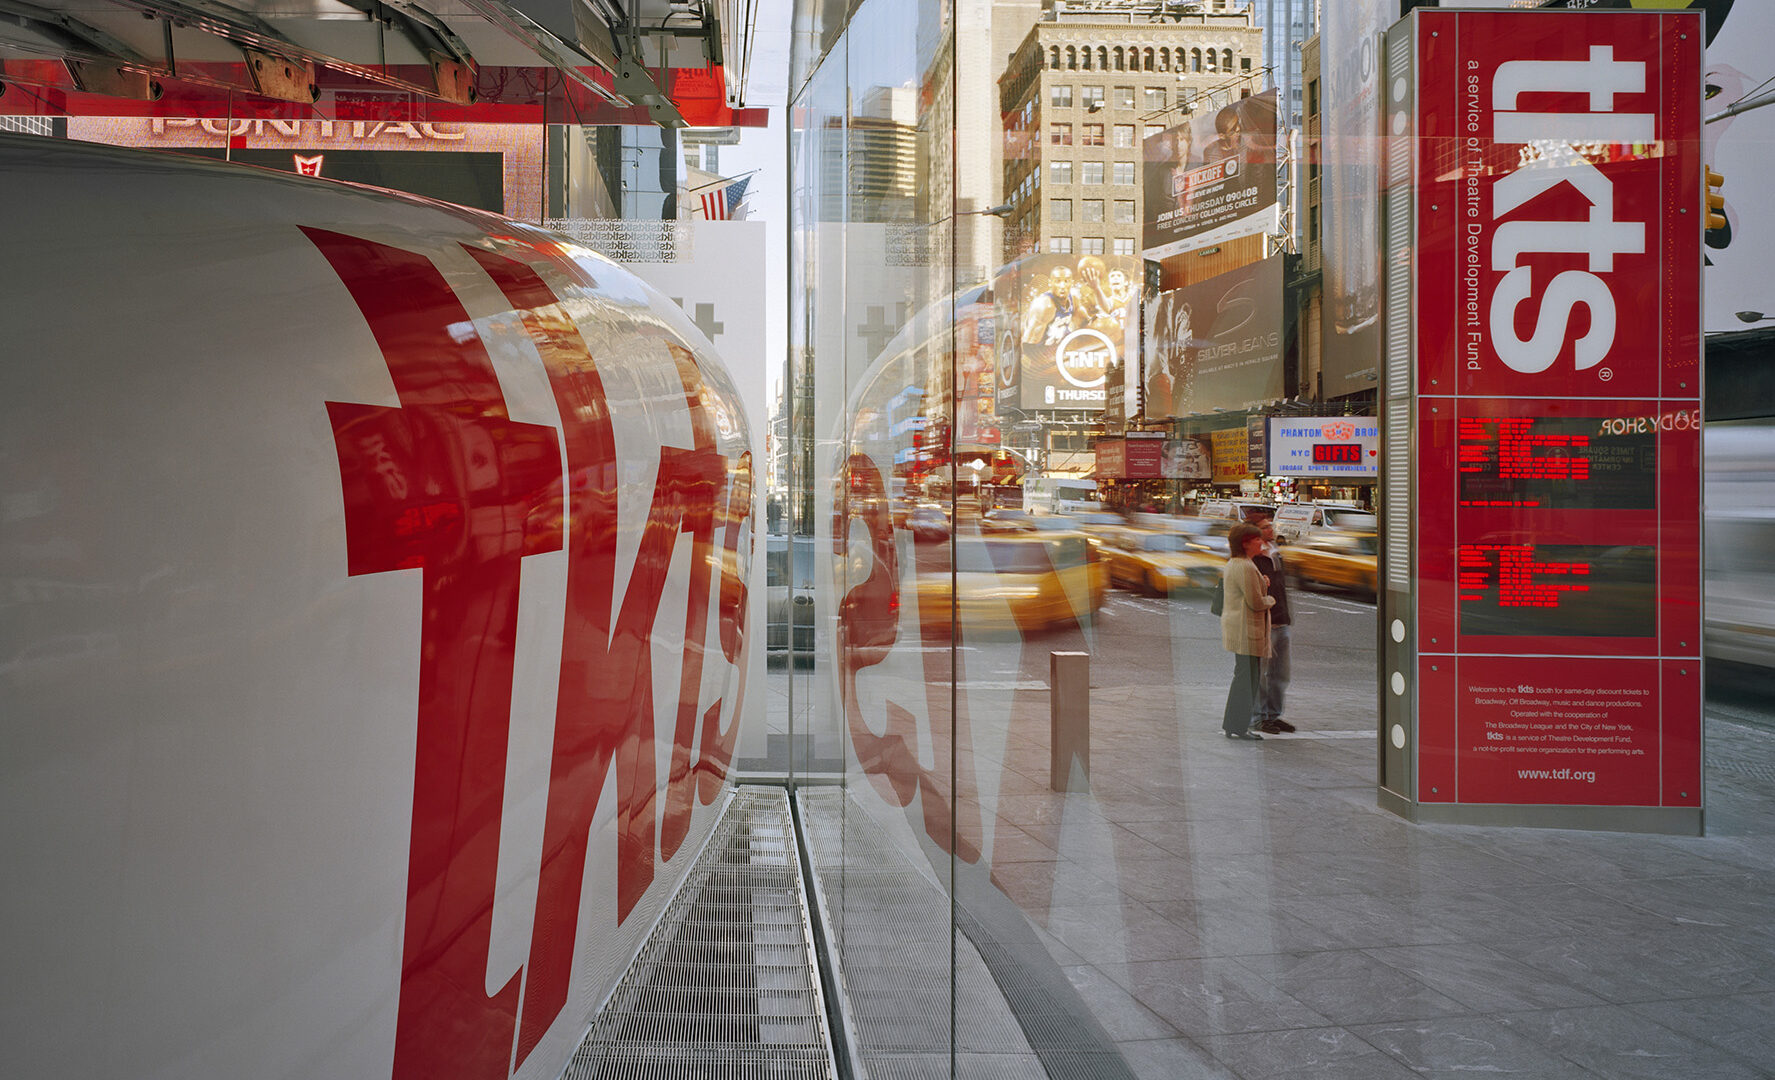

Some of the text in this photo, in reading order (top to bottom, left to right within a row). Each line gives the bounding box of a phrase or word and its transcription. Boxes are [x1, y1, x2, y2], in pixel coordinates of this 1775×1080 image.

[1188, 165, 1223, 187] KICKOFF
[1157, 186, 1258, 223] JOIN US THURSDAY 090408
[1157, 220, 1173, 231] FREE
[1172, 213, 1199, 227] CONCERT
[1199, 203, 1234, 220] COLUMBUS
[1234, 196, 1258, 210] CIRCLE
[1463, 59, 1484, 372] a service of Theatre Development Fund
[1197, 331, 1279, 362] SILVER JEANS
[1064, 350, 1109, 369] TNT
[1280, 427, 1322, 438] PHANTOM
[1290, 449, 1310, 457] NYC
[1315, 445, 1360, 461] GIFTS
[1517, 684, 1534, 694] tkts
[1564, 688, 1596, 696] same-day
[1596, 687, 1622, 695] discount
[1519, 698, 1552, 707] Broadway,
[1510, 710, 1539, 718] Operated
[1498, 722, 1529, 730] Broadway
[1580, 723, 1593, 731] City
[1486, 731, 1504, 741] tkts
[1573, 735, 1614, 743] Development
[1597, 748, 1631, 756] performing
[1517, 768, 1596, 783] www.tdf.org
